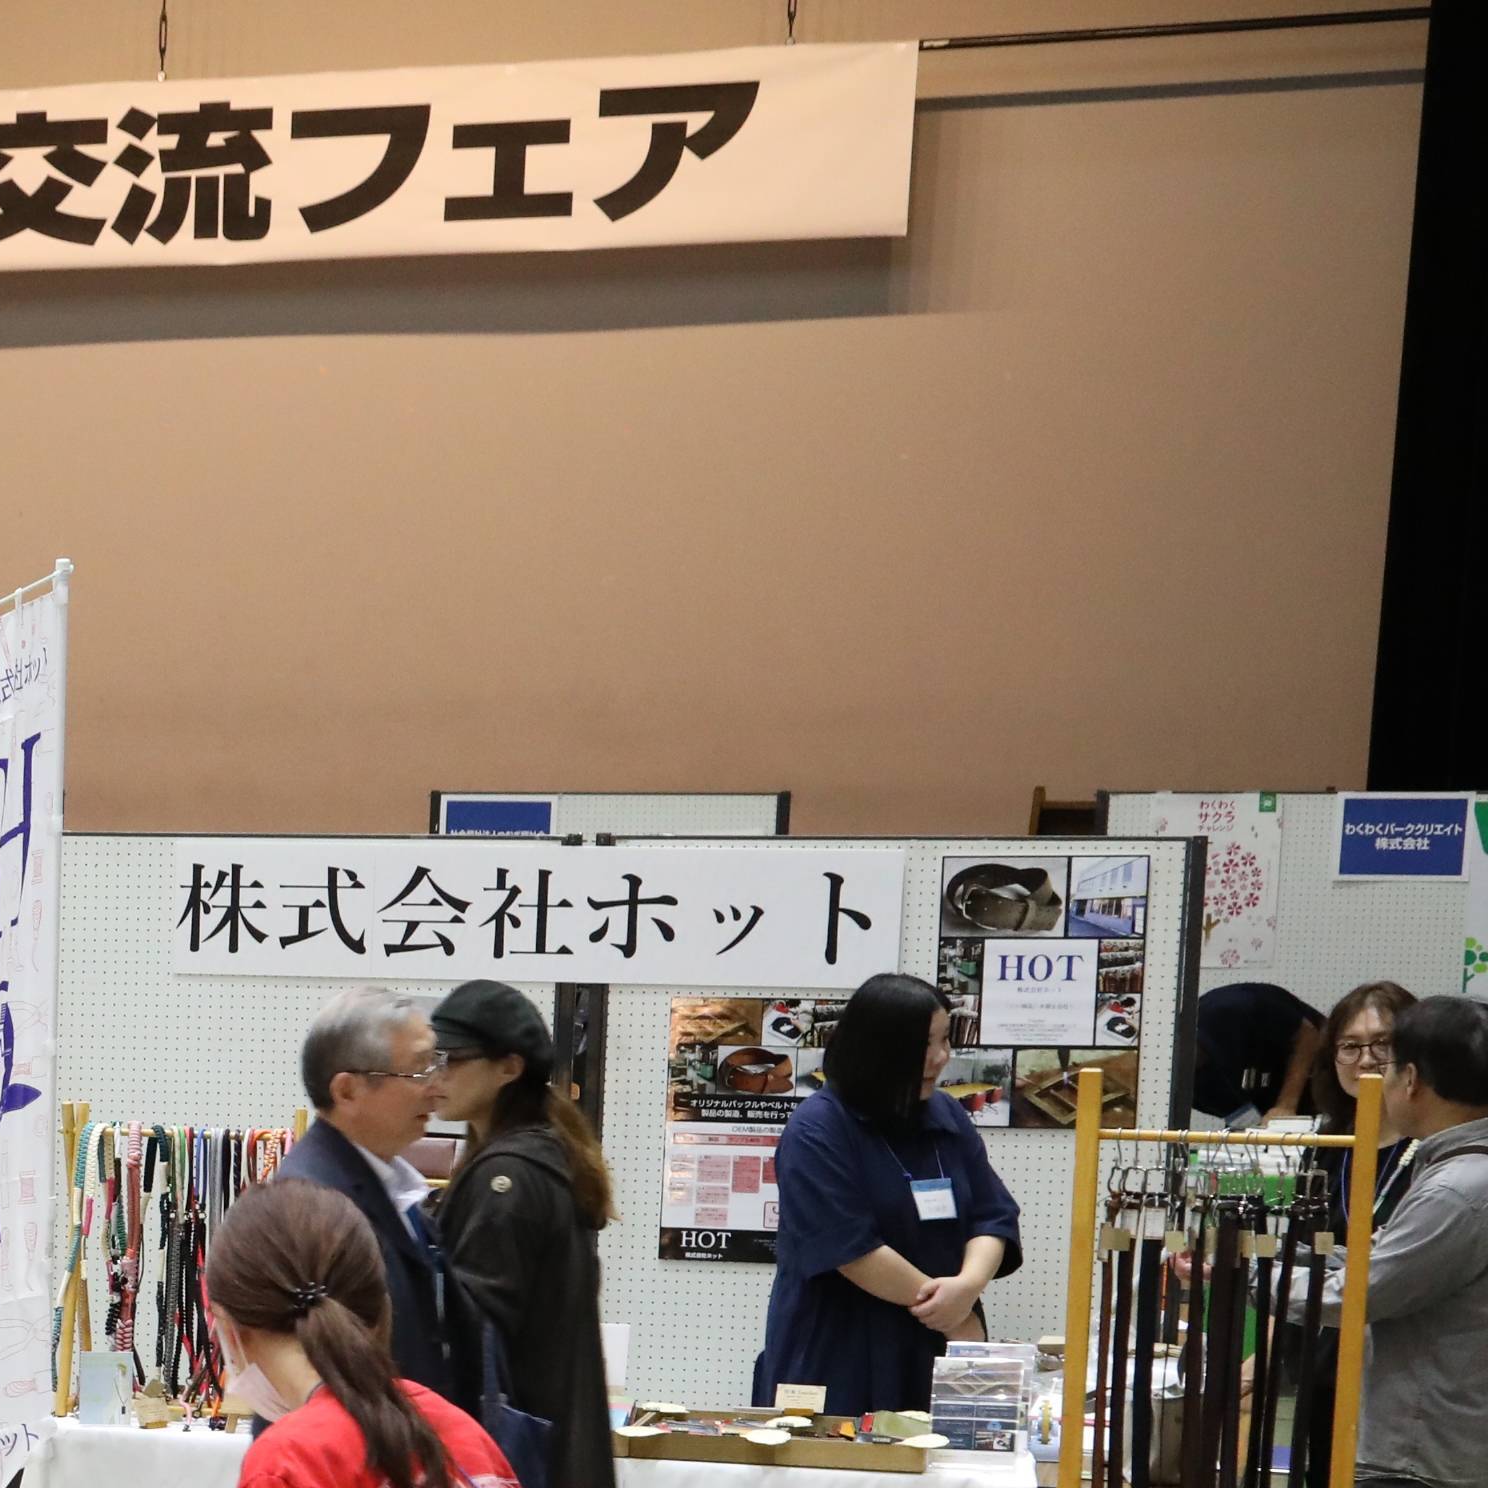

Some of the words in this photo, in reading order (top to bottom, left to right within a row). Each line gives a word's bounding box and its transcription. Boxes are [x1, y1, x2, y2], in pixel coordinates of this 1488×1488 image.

[1198, 811, 1236, 823] サクラ
[1375, 837, 1430, 850] 株式会社
[176, 862, 872, 966] 株式会社ホット
[997, 953, 1084, 982] HOT
[680, 1230, 732, 1250] HOT
